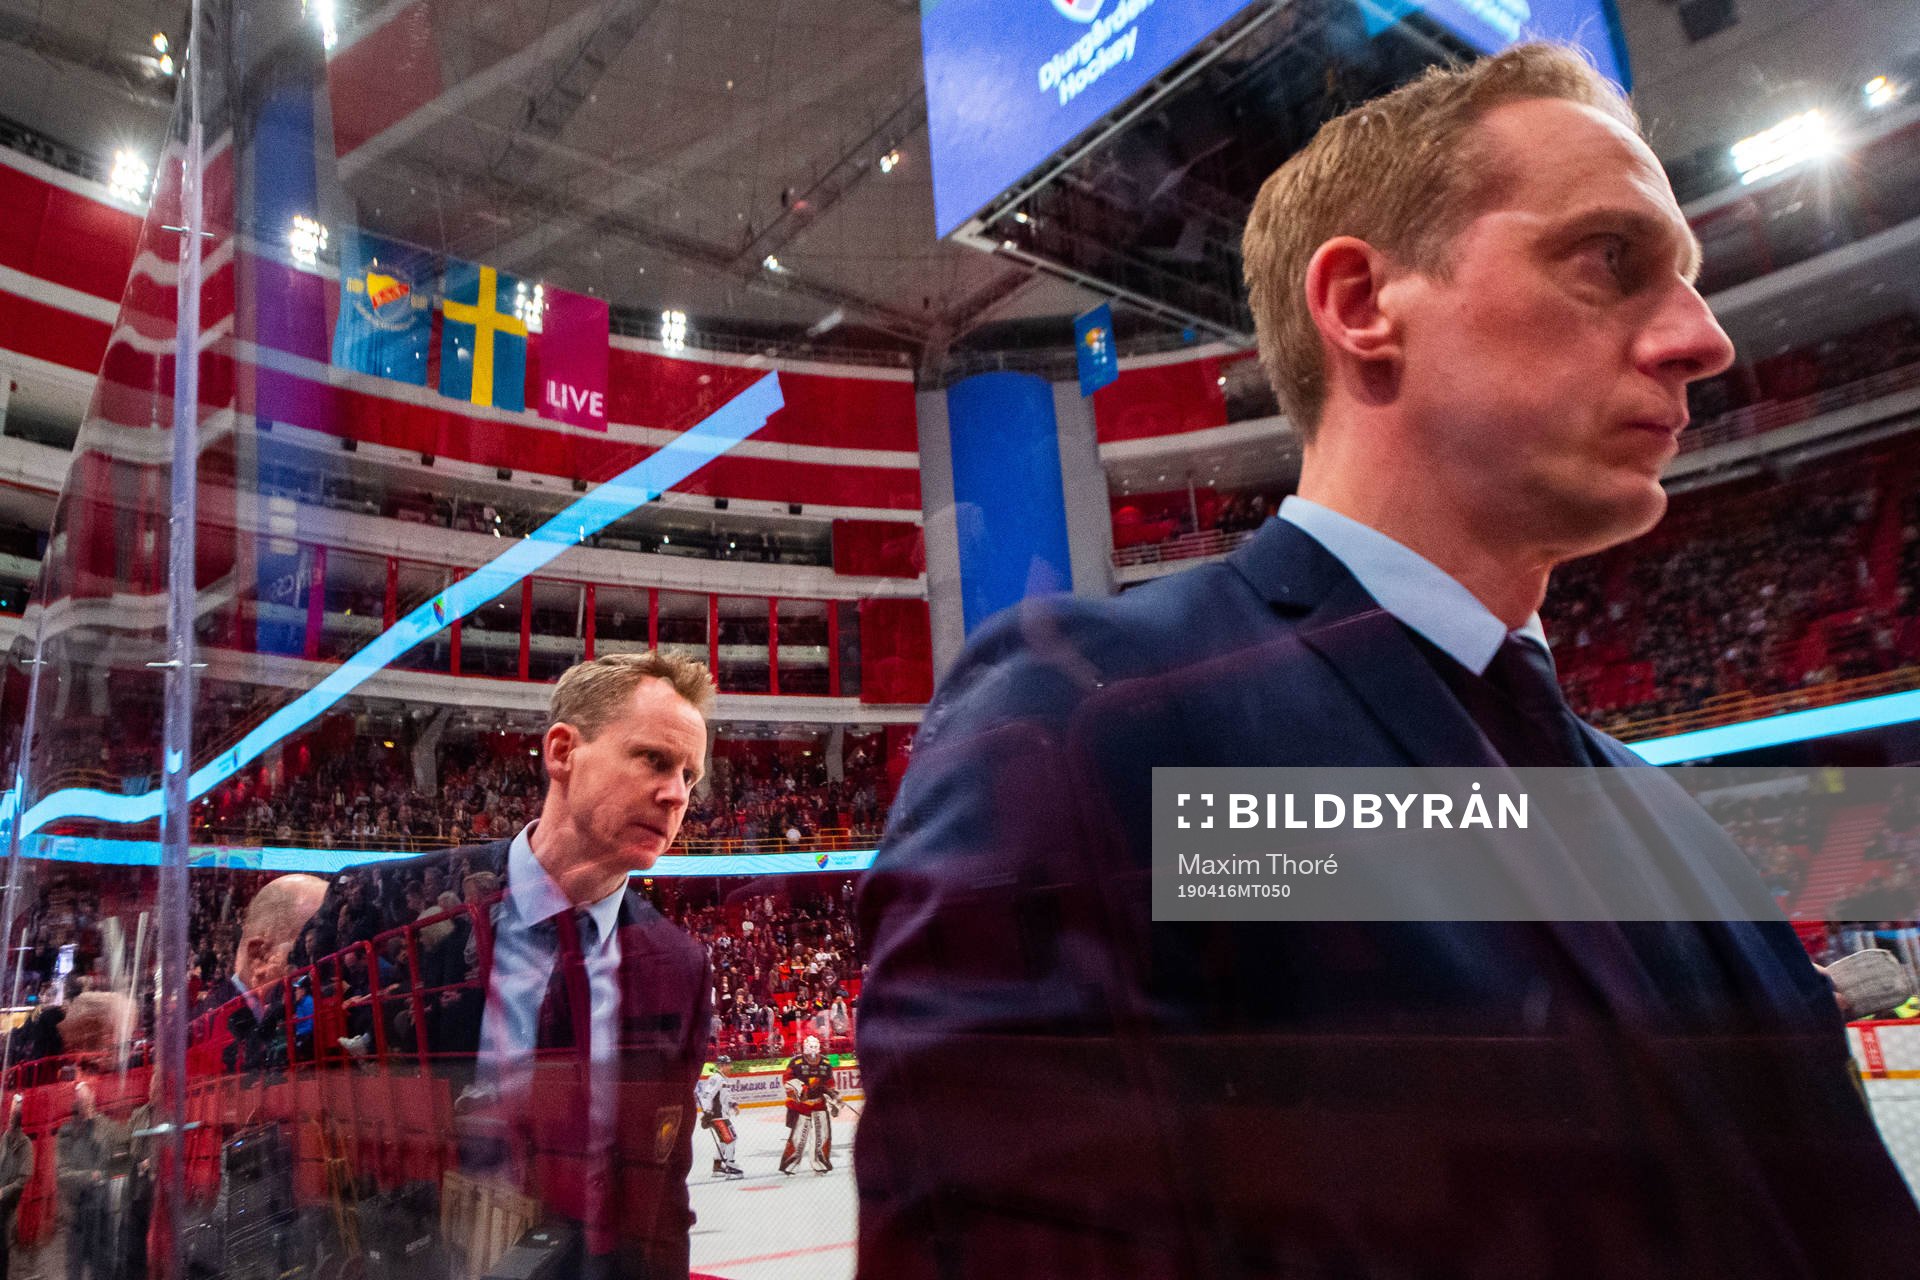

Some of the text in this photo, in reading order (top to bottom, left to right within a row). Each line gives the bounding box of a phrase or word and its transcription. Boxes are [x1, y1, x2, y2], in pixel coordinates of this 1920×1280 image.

[1038, 0, 1154, 93] Djurgårde
[1058, 26, 1138, 107] Hockey
[546, 379, 604, 418] LIVE
